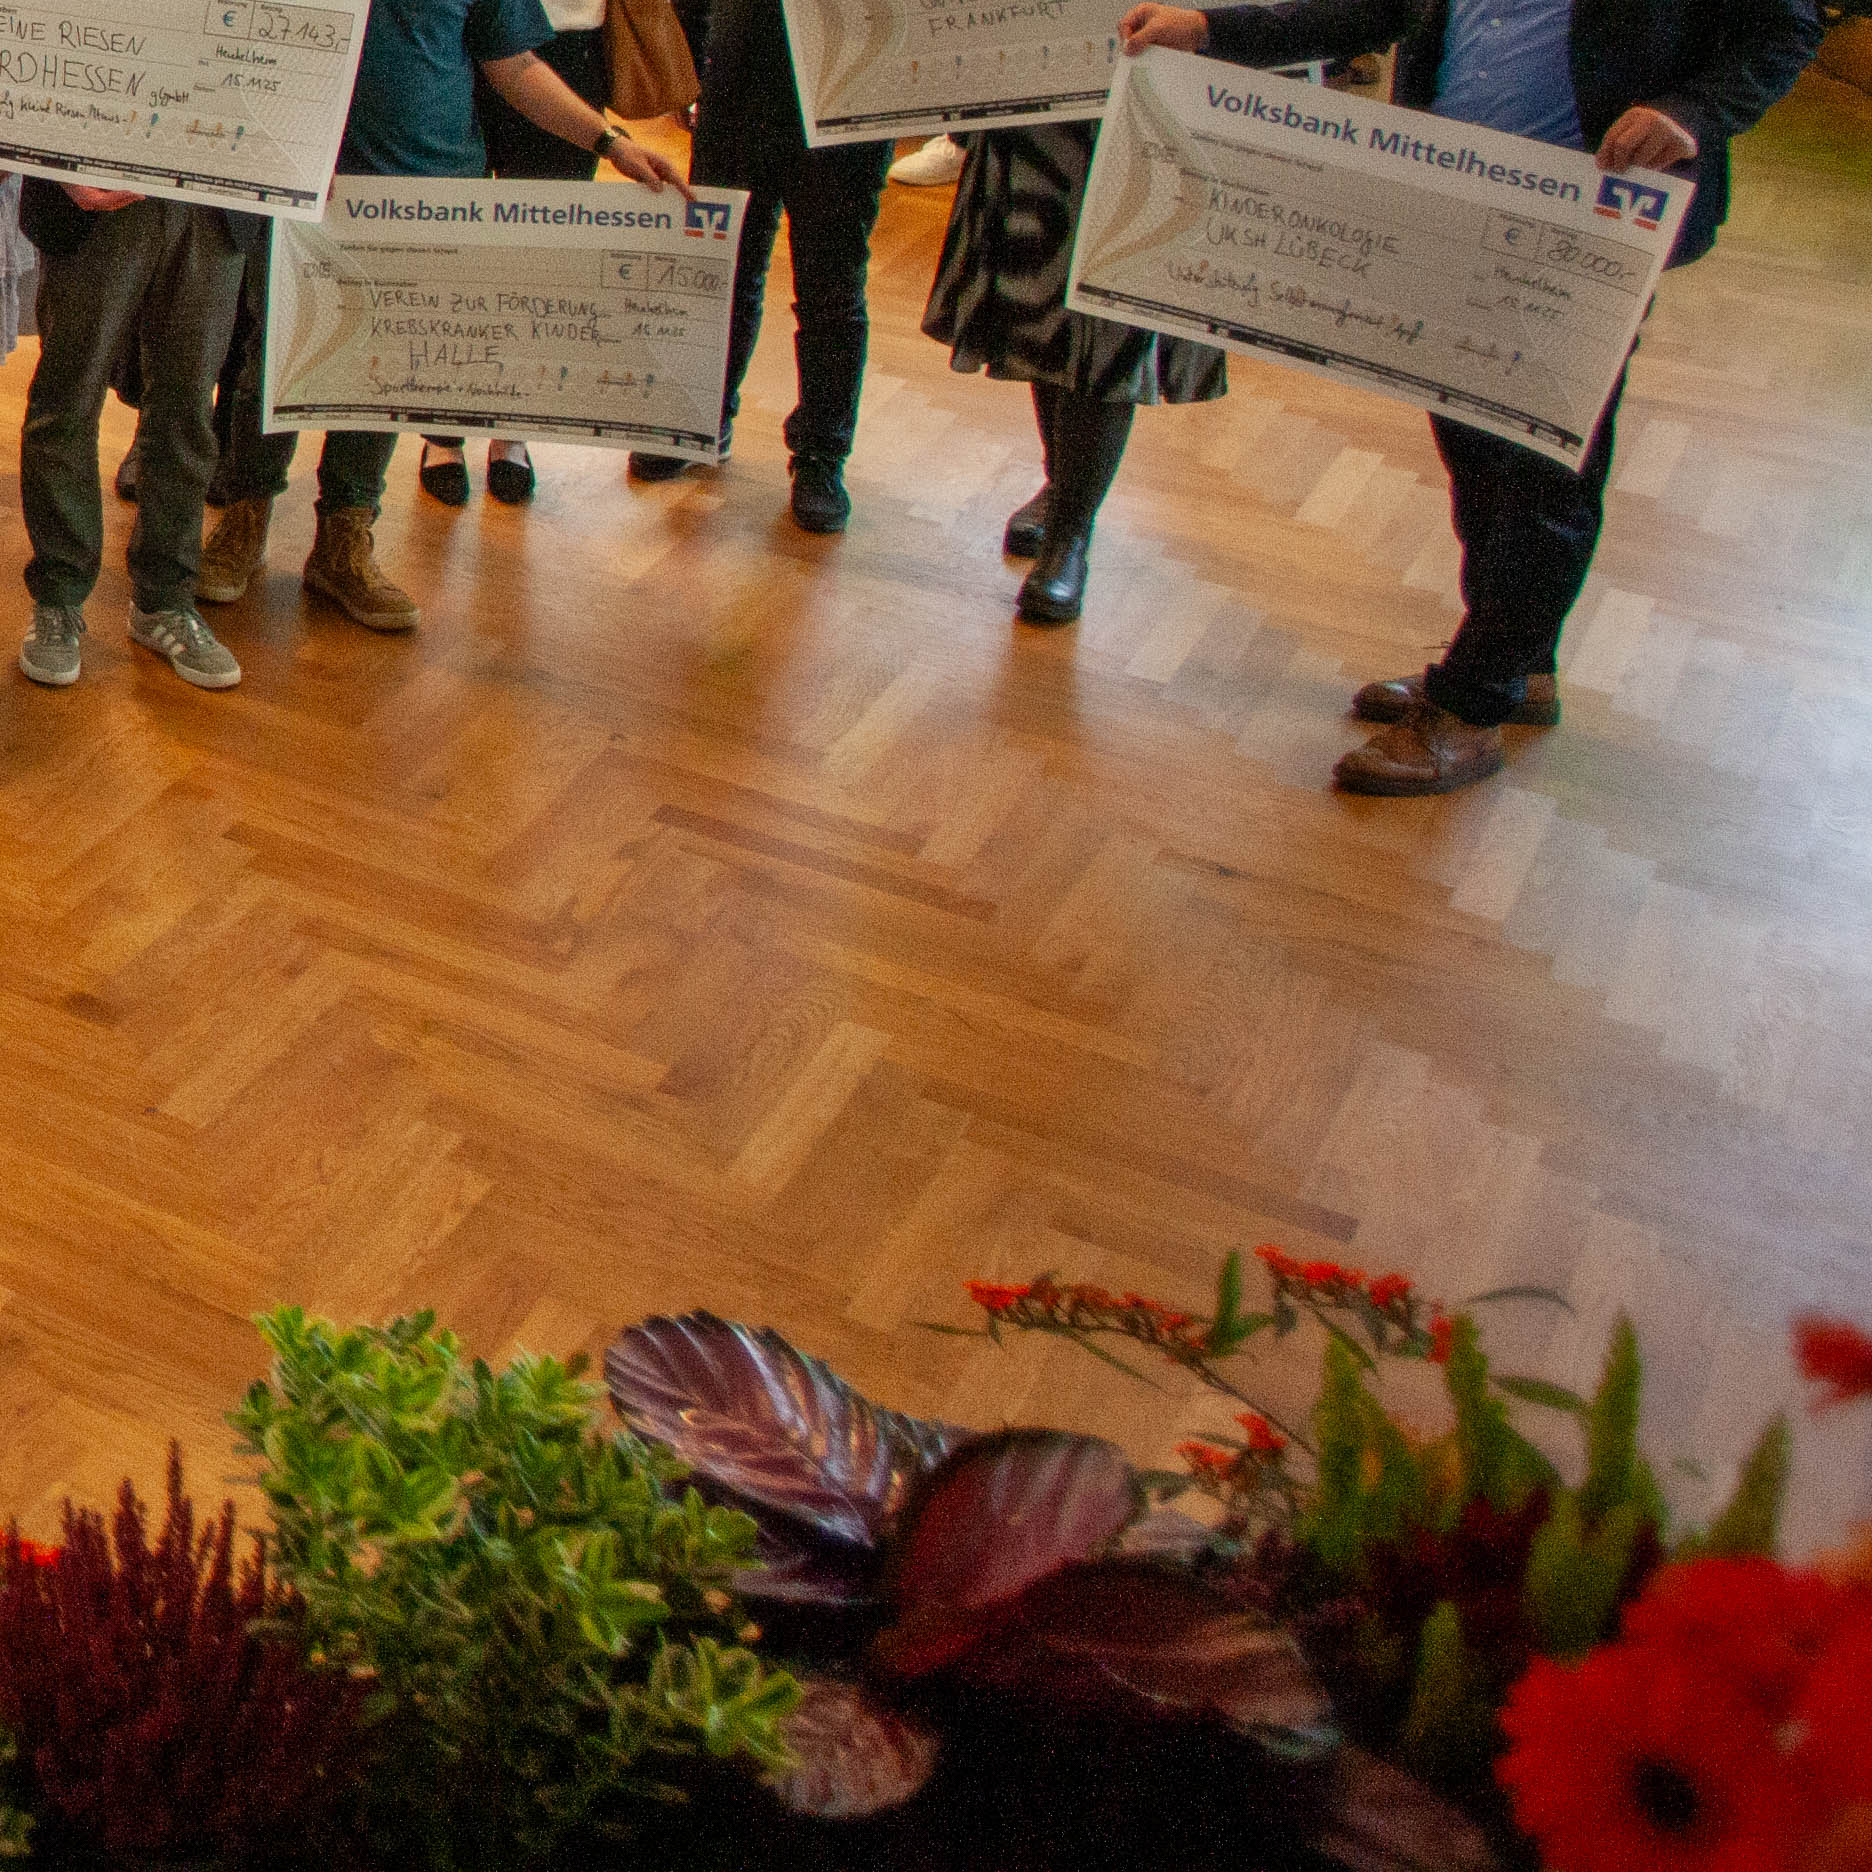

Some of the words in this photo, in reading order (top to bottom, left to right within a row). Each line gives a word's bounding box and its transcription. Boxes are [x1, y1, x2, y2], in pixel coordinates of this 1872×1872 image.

[221, 9, 236, 27] €
[58, 19, 146, 55] RIESEN
[1207, 85, 1357, 144] Volksbank
[1369, 128, 1579, 201] Mittelhessen
[345, 198, 482, 222] Volksbank
[493, 202, 670, 228] Mittelhessen
[1208, 189, 1398, 255] KINDERONKOLOGIE
[1204, 222, 1266, 248] UKSH
[1273, 234, 1371, 278] LÜBECK
[1502, 226, 1521, 246] €
[617, 262, 632, 280] €
[370, 289, 439, 308] VEREIN
[450, 292, 488, 313] ZUR
[496, 291, 599, 322] FÖRDERUNG
[370, 316, 518, 340] KREBSKRANKER
[531, 320, 603, 347] KINDER
[408, 340, 505, 373] HALLE
